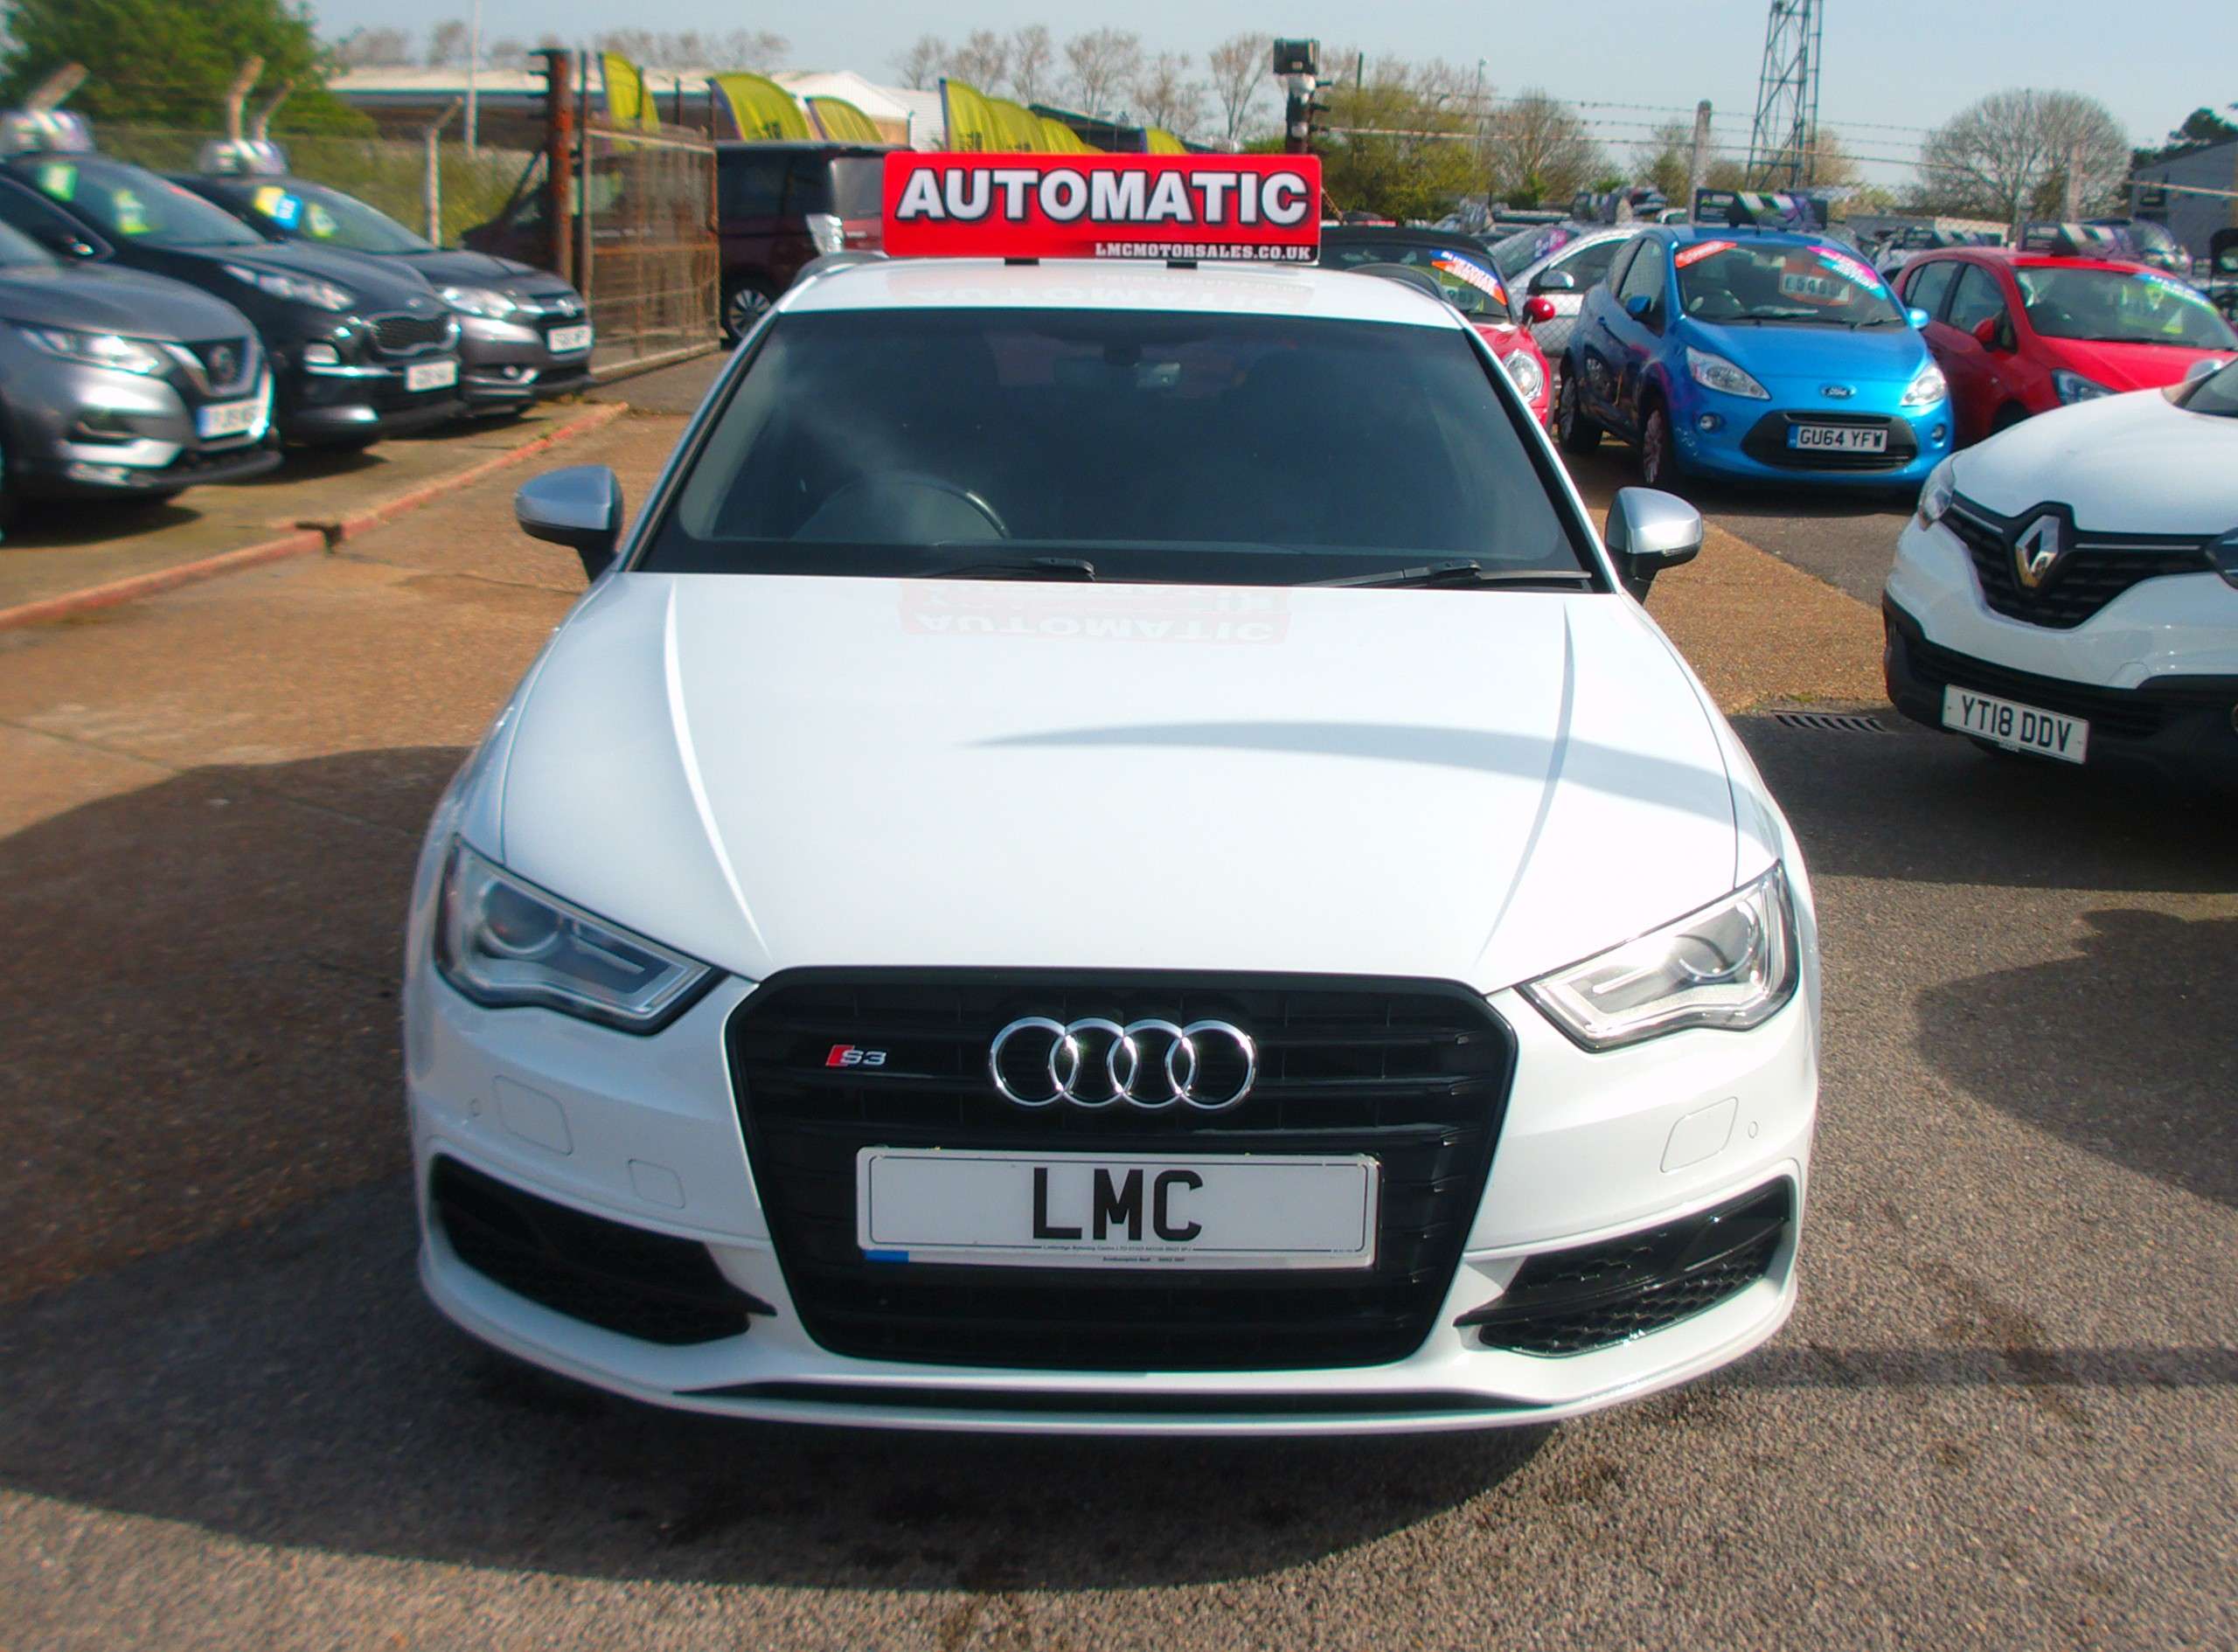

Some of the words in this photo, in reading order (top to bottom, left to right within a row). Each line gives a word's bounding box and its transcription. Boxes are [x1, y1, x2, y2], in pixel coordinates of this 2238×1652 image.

[894, 167, 1310, 226] AUTOMATIC
[1095, 242, 1311, 260] LMCMOTORSALES.CO.UK
[1799, 428, 1845, 446] GU64
[1851, 431, 1884, 448] YFW
[1962, 694, 2014, 737] YT18
[2019, 711, 2073, 752] DDV
[839, 1049, 887, 1065] S3
[1032, 1167, 1204, 1242] LMC
